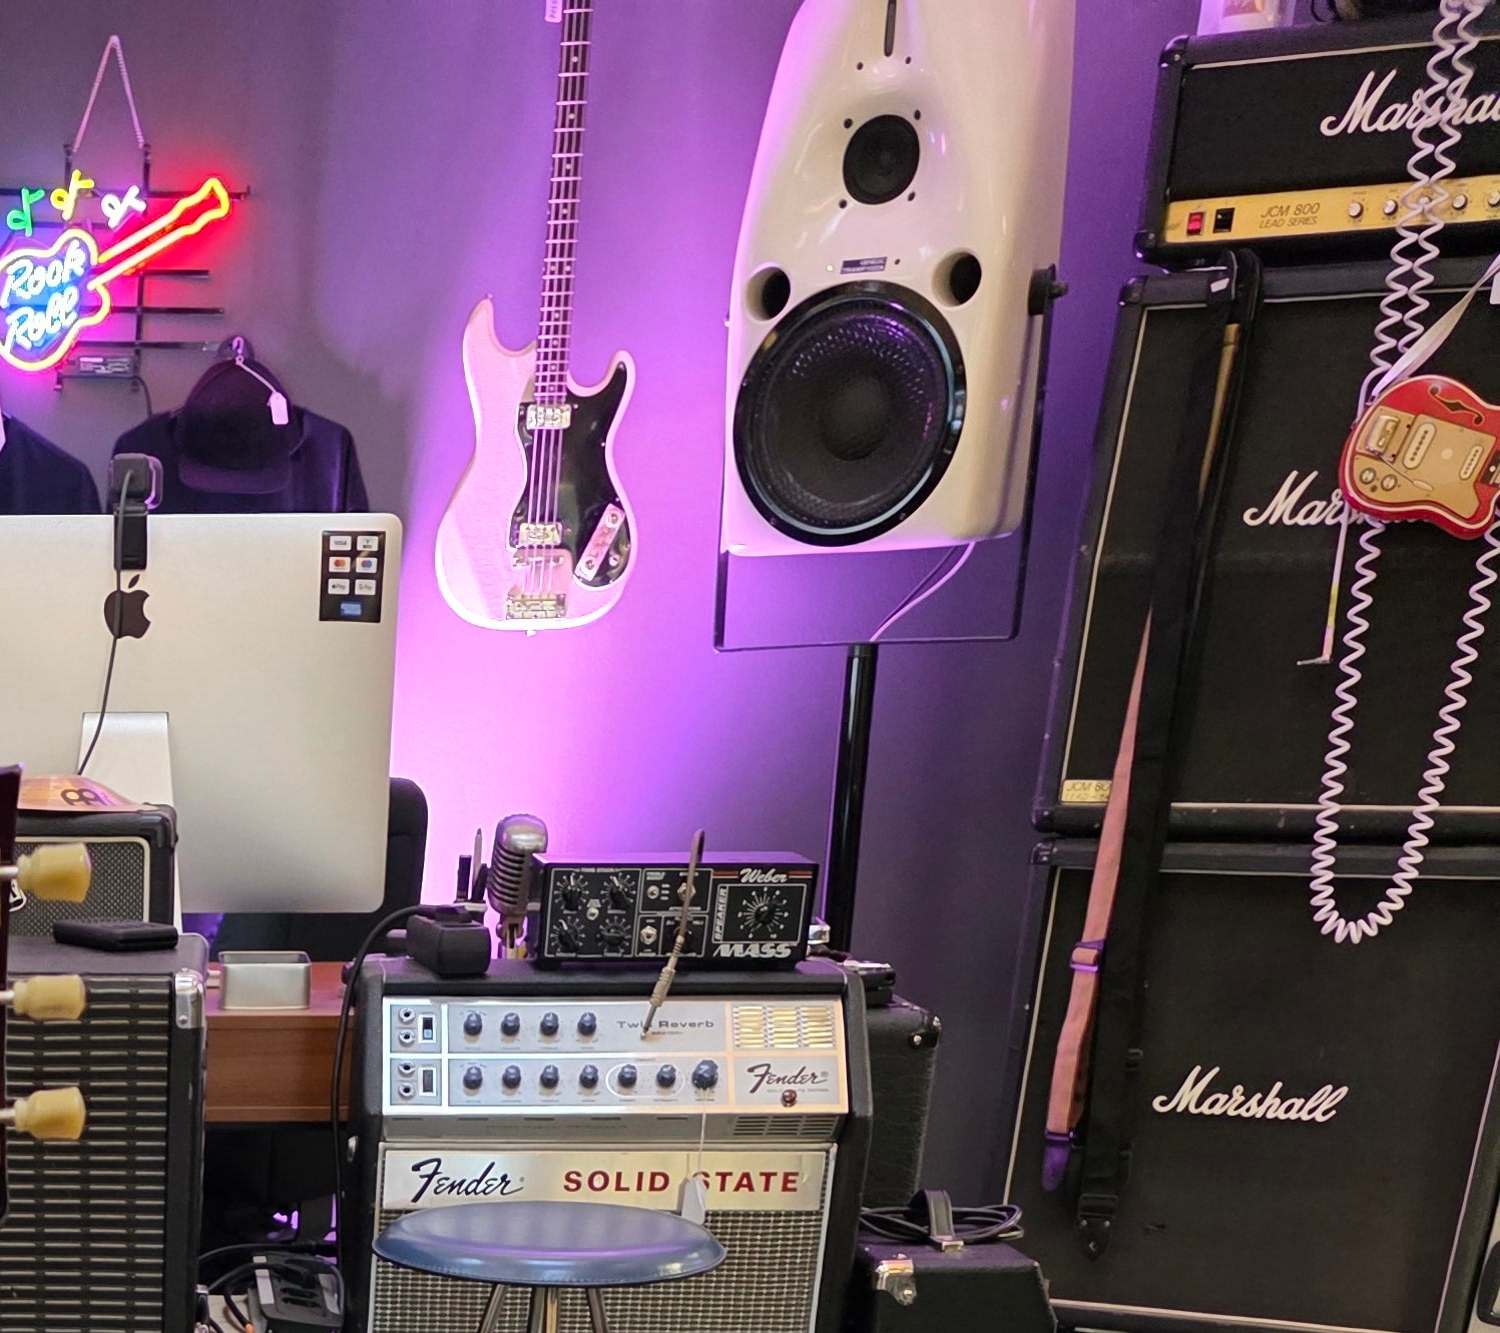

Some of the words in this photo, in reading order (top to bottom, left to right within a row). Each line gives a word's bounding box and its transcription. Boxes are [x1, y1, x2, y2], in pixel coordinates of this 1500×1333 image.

[1261, 206, 1289, 218] JCM
[1293, 202, 1321, 215] 800
[1259, 219, 1286, 229] LEAD
[1287, 216, 1318, 227] SERIES
[1, 286, 79, 352] Roll
[740, 868, 788, 883] Weber
[714, 887, 727, 941] SPEAKER
[712, 942, 792, 958] MASS
[616, 1020, 653, 1029] Twi
[658, 1019, 715, 1029] Reverb
[747, 1062, 829, 1094] Fender
[1152, 1065, 1349, 1122] Marshall
[411, 1157, 525, 1203] Fender
[563, 1170, 670, 1192] SOLID
